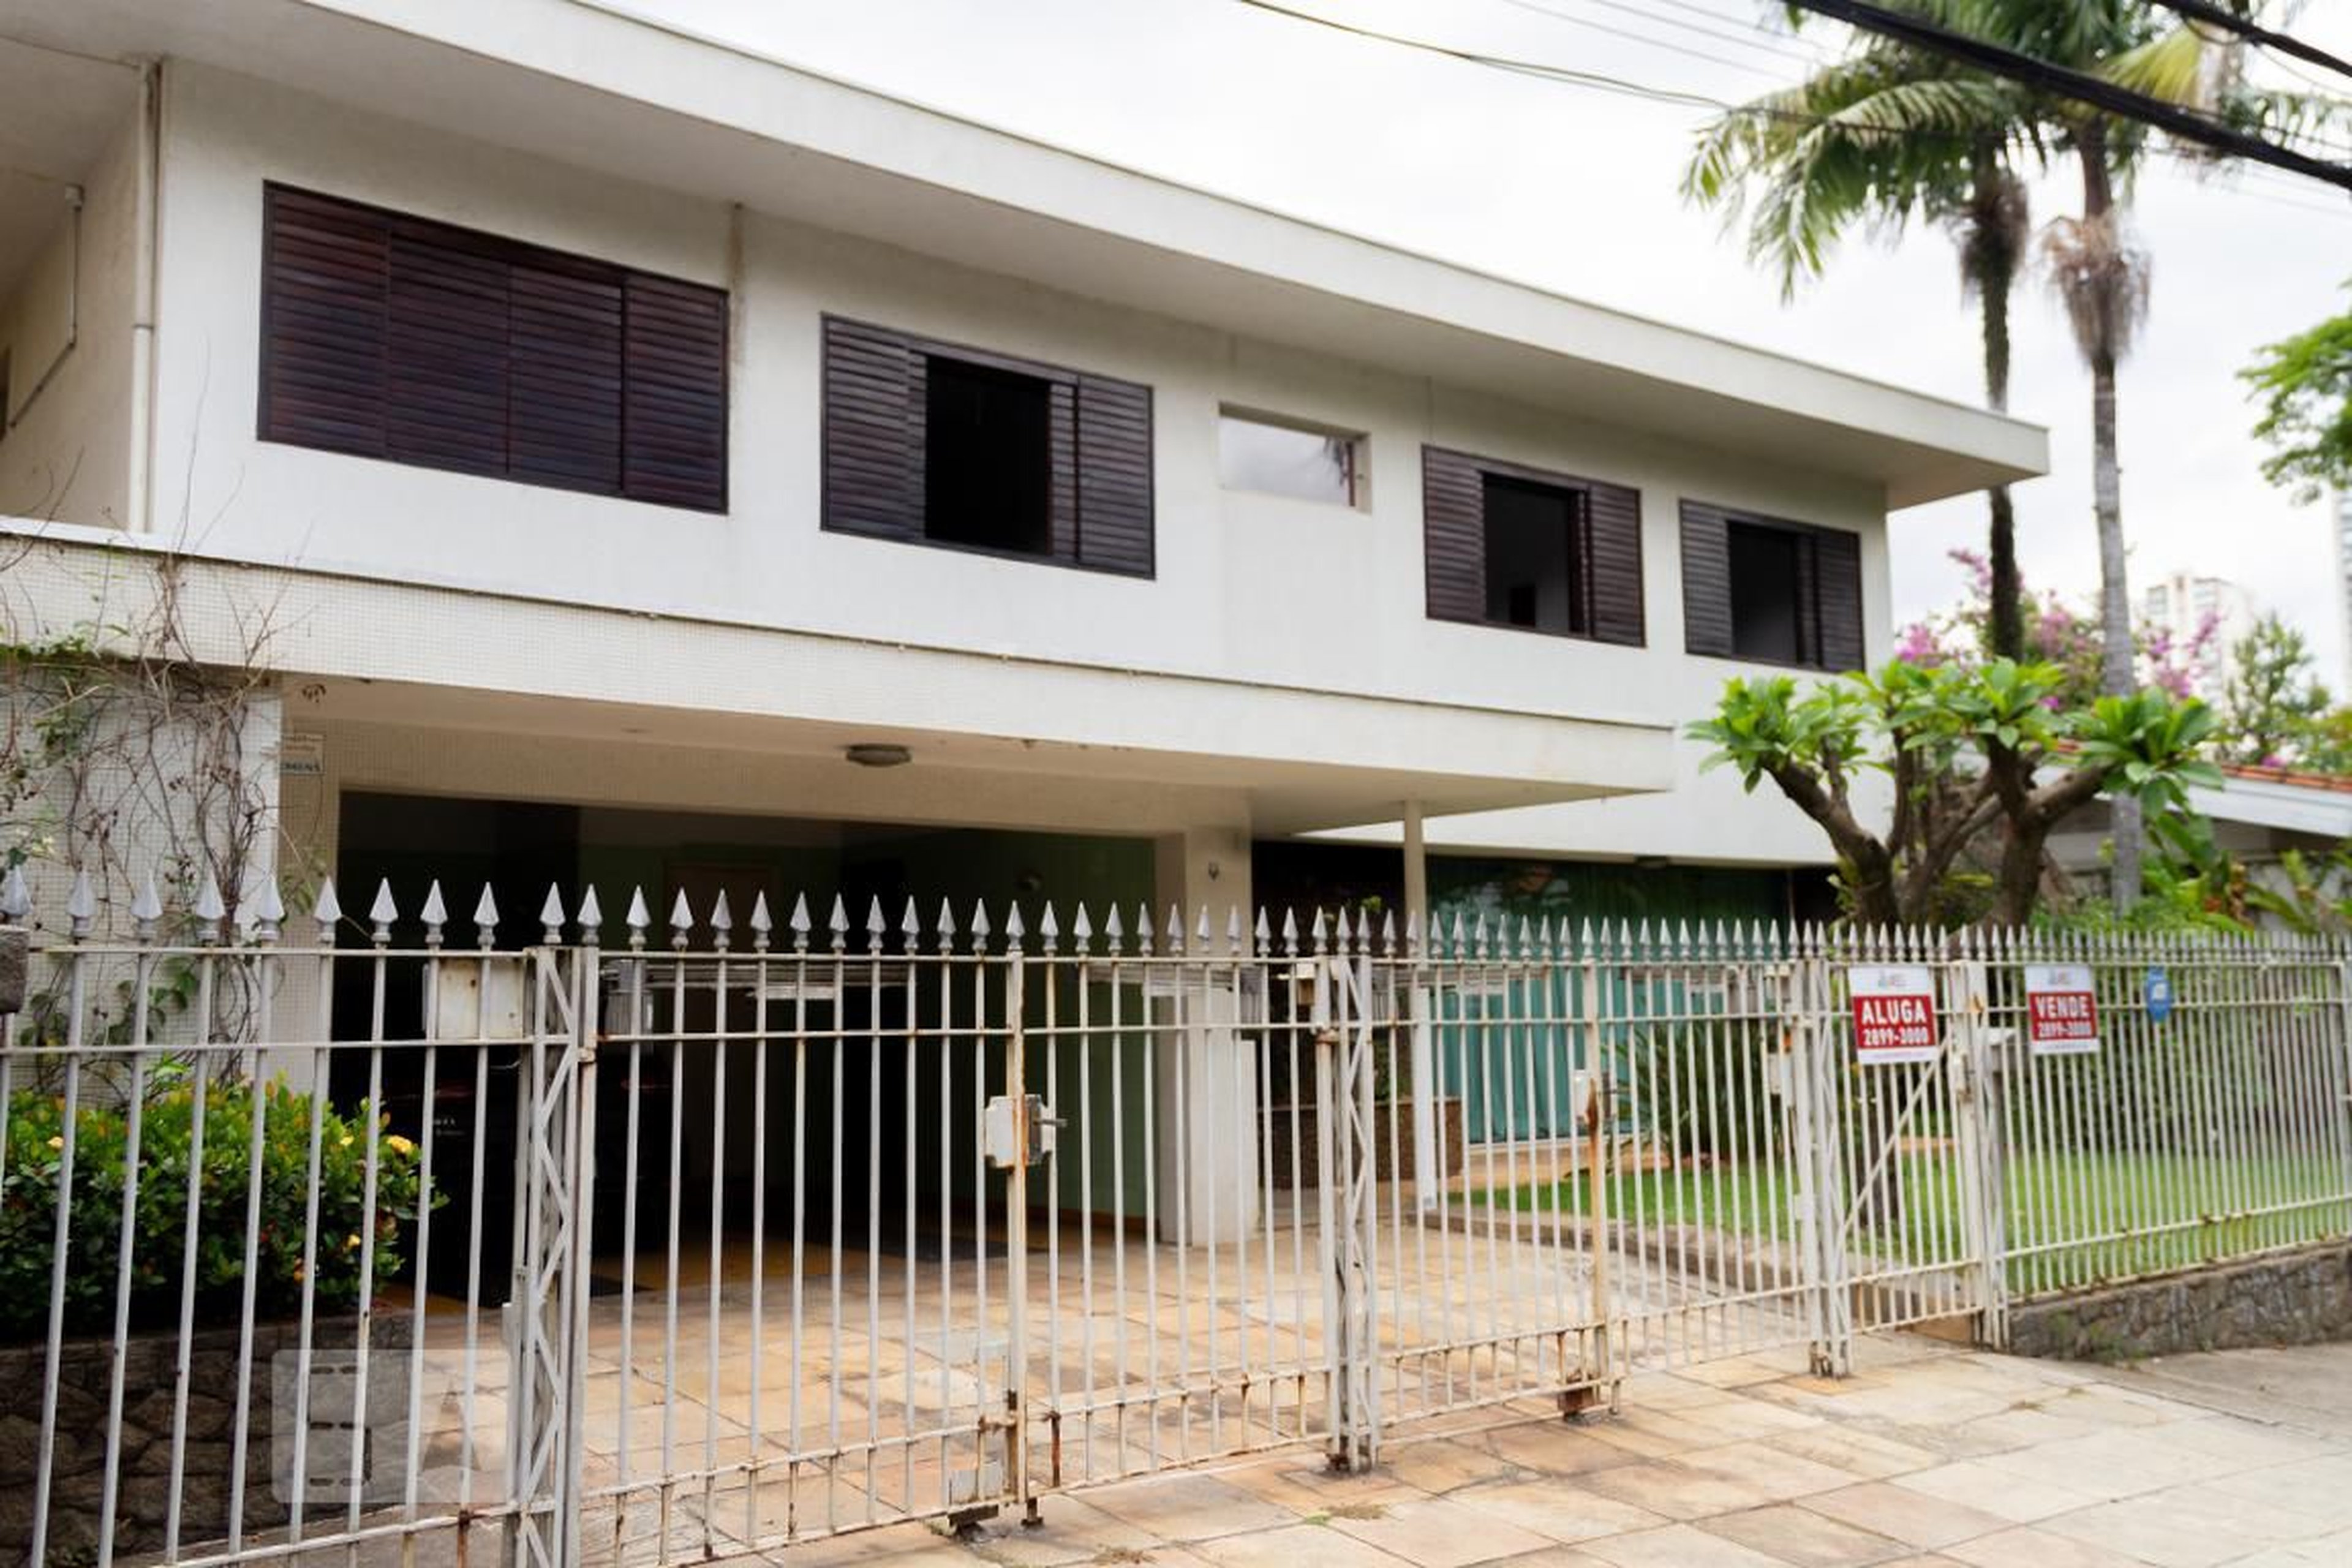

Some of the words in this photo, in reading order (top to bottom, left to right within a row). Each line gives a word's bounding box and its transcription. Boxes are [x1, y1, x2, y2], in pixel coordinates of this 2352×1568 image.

[1861, 998, 1928, 1025] ALUGA
[2034, 995, 2090, 1019] VENDE
[1862, 1026, 1929, 1046] 2899-3000
